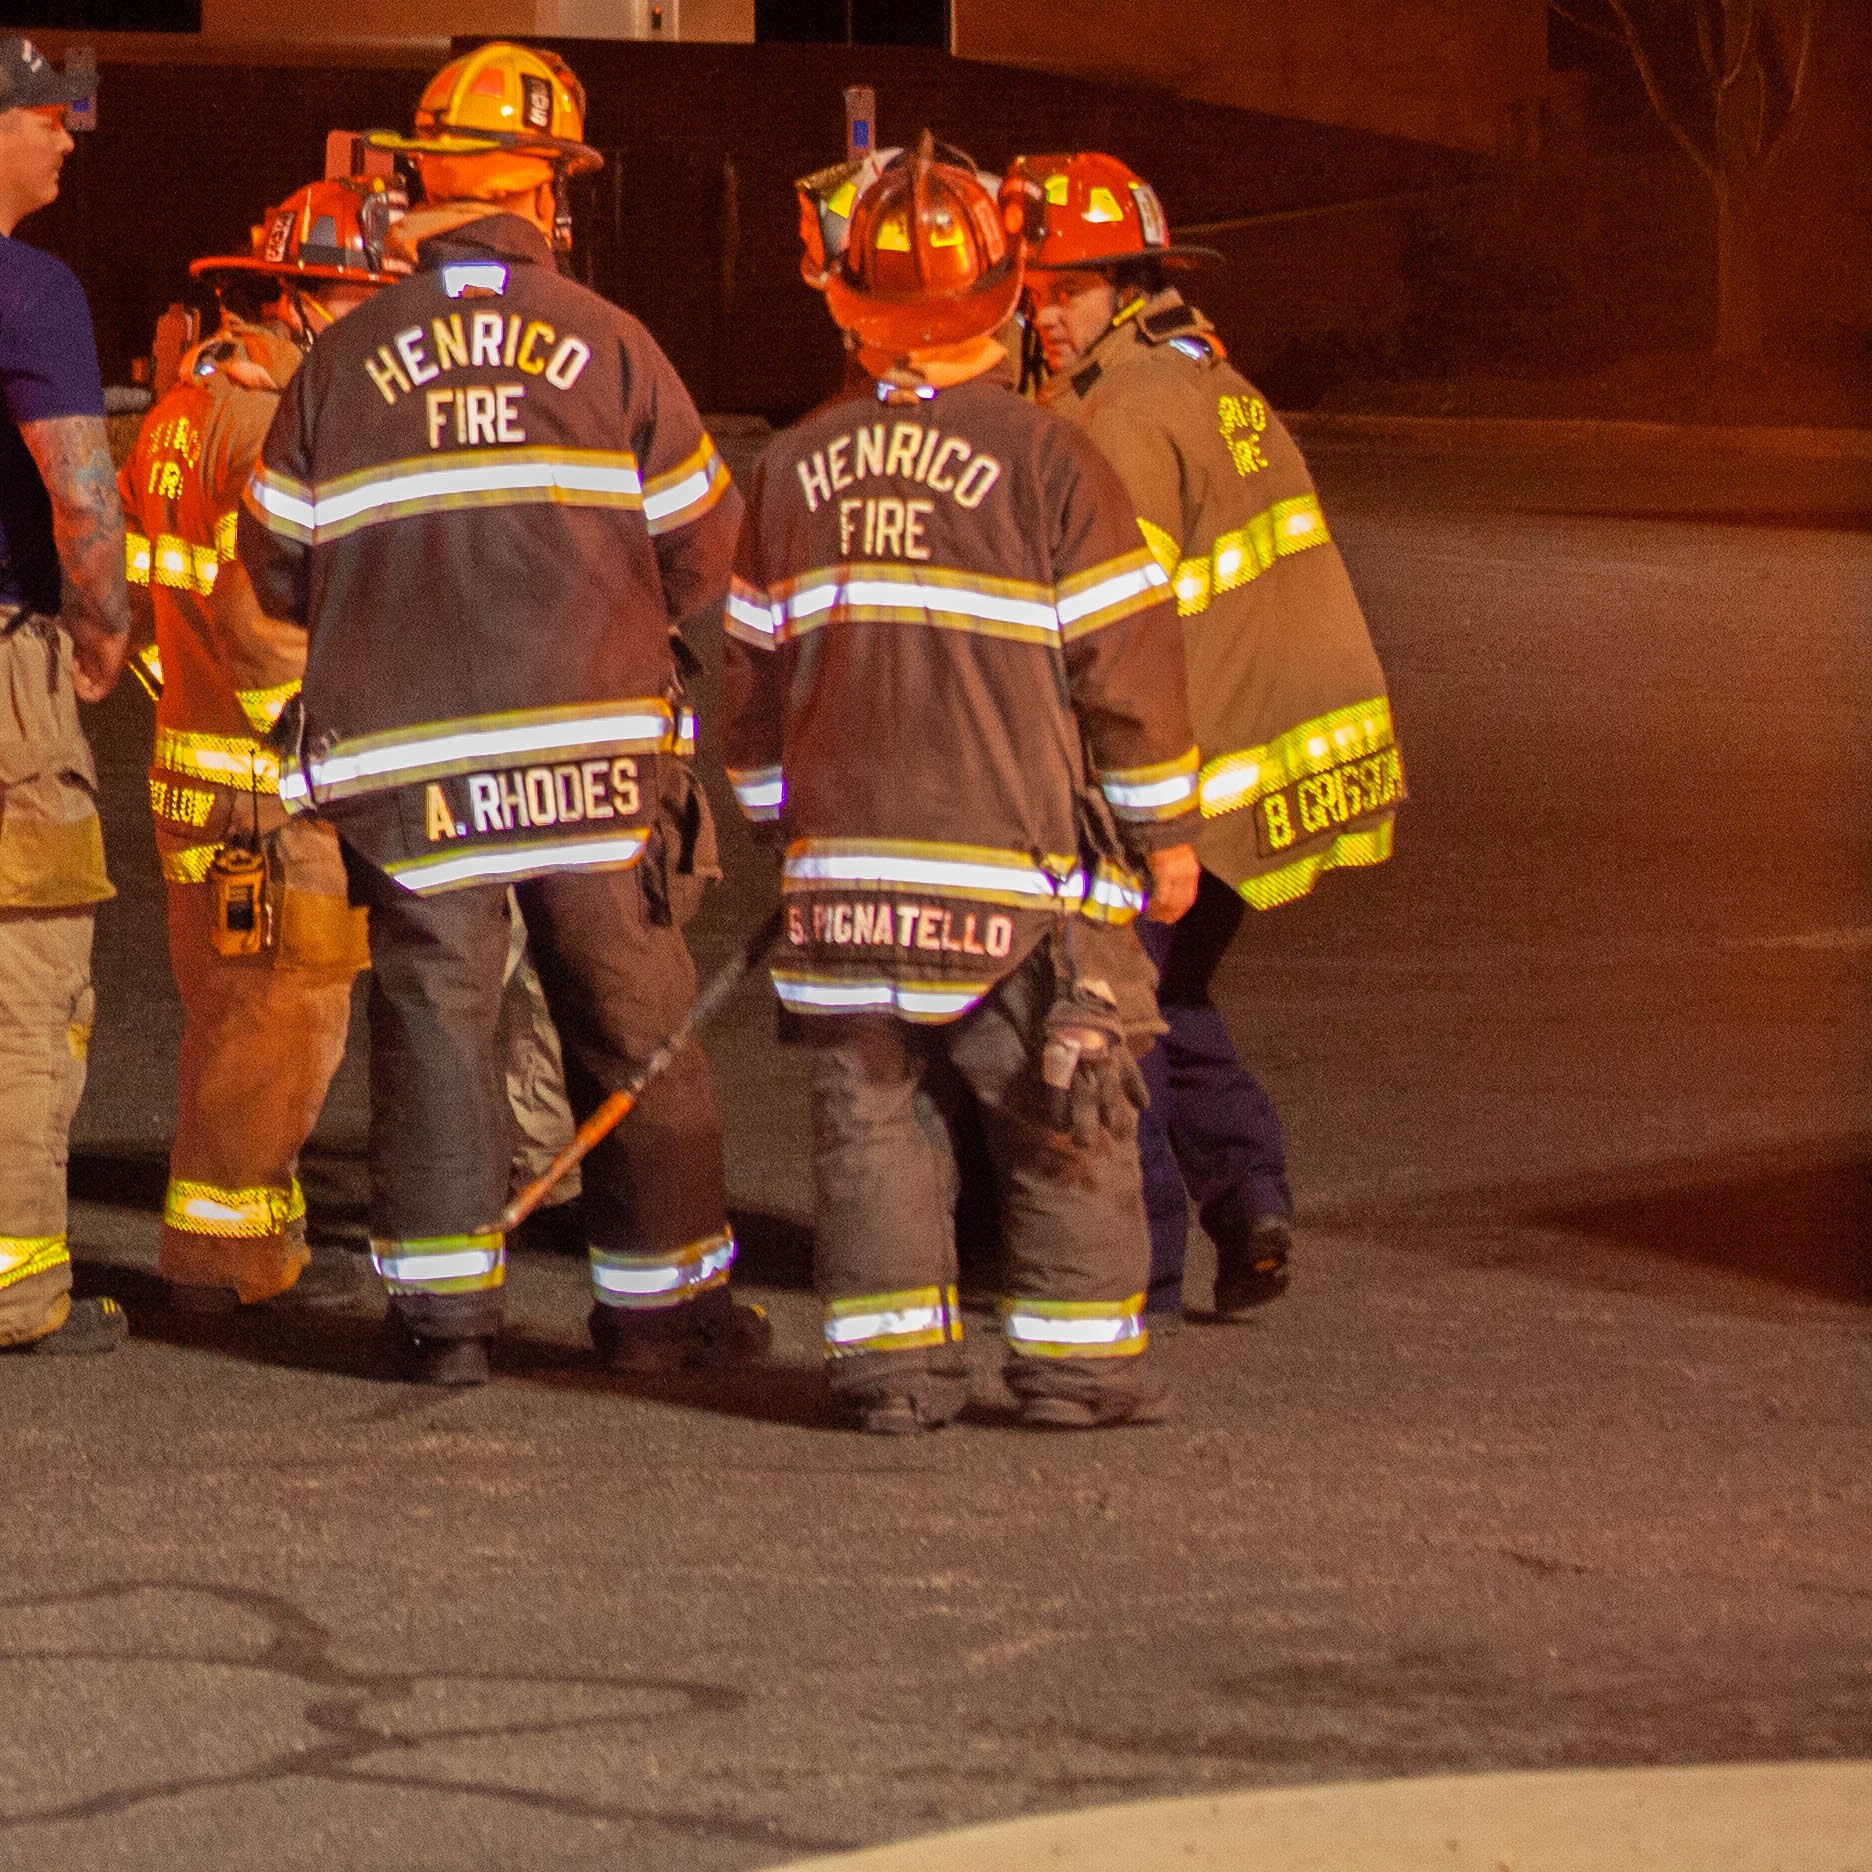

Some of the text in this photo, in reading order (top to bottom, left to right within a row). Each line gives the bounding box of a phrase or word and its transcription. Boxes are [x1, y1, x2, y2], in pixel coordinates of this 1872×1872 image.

[364, 308, 592, 406] HENRICO
[426, 381, 526, 449] FIRE
[796, 421, 1002, 513] HENRICO
[839, 496, 936, 560] FIRE
[426, 757, 641, 842] A. RHODES
[812, 902, 1013, 958] PIGNATELLO
